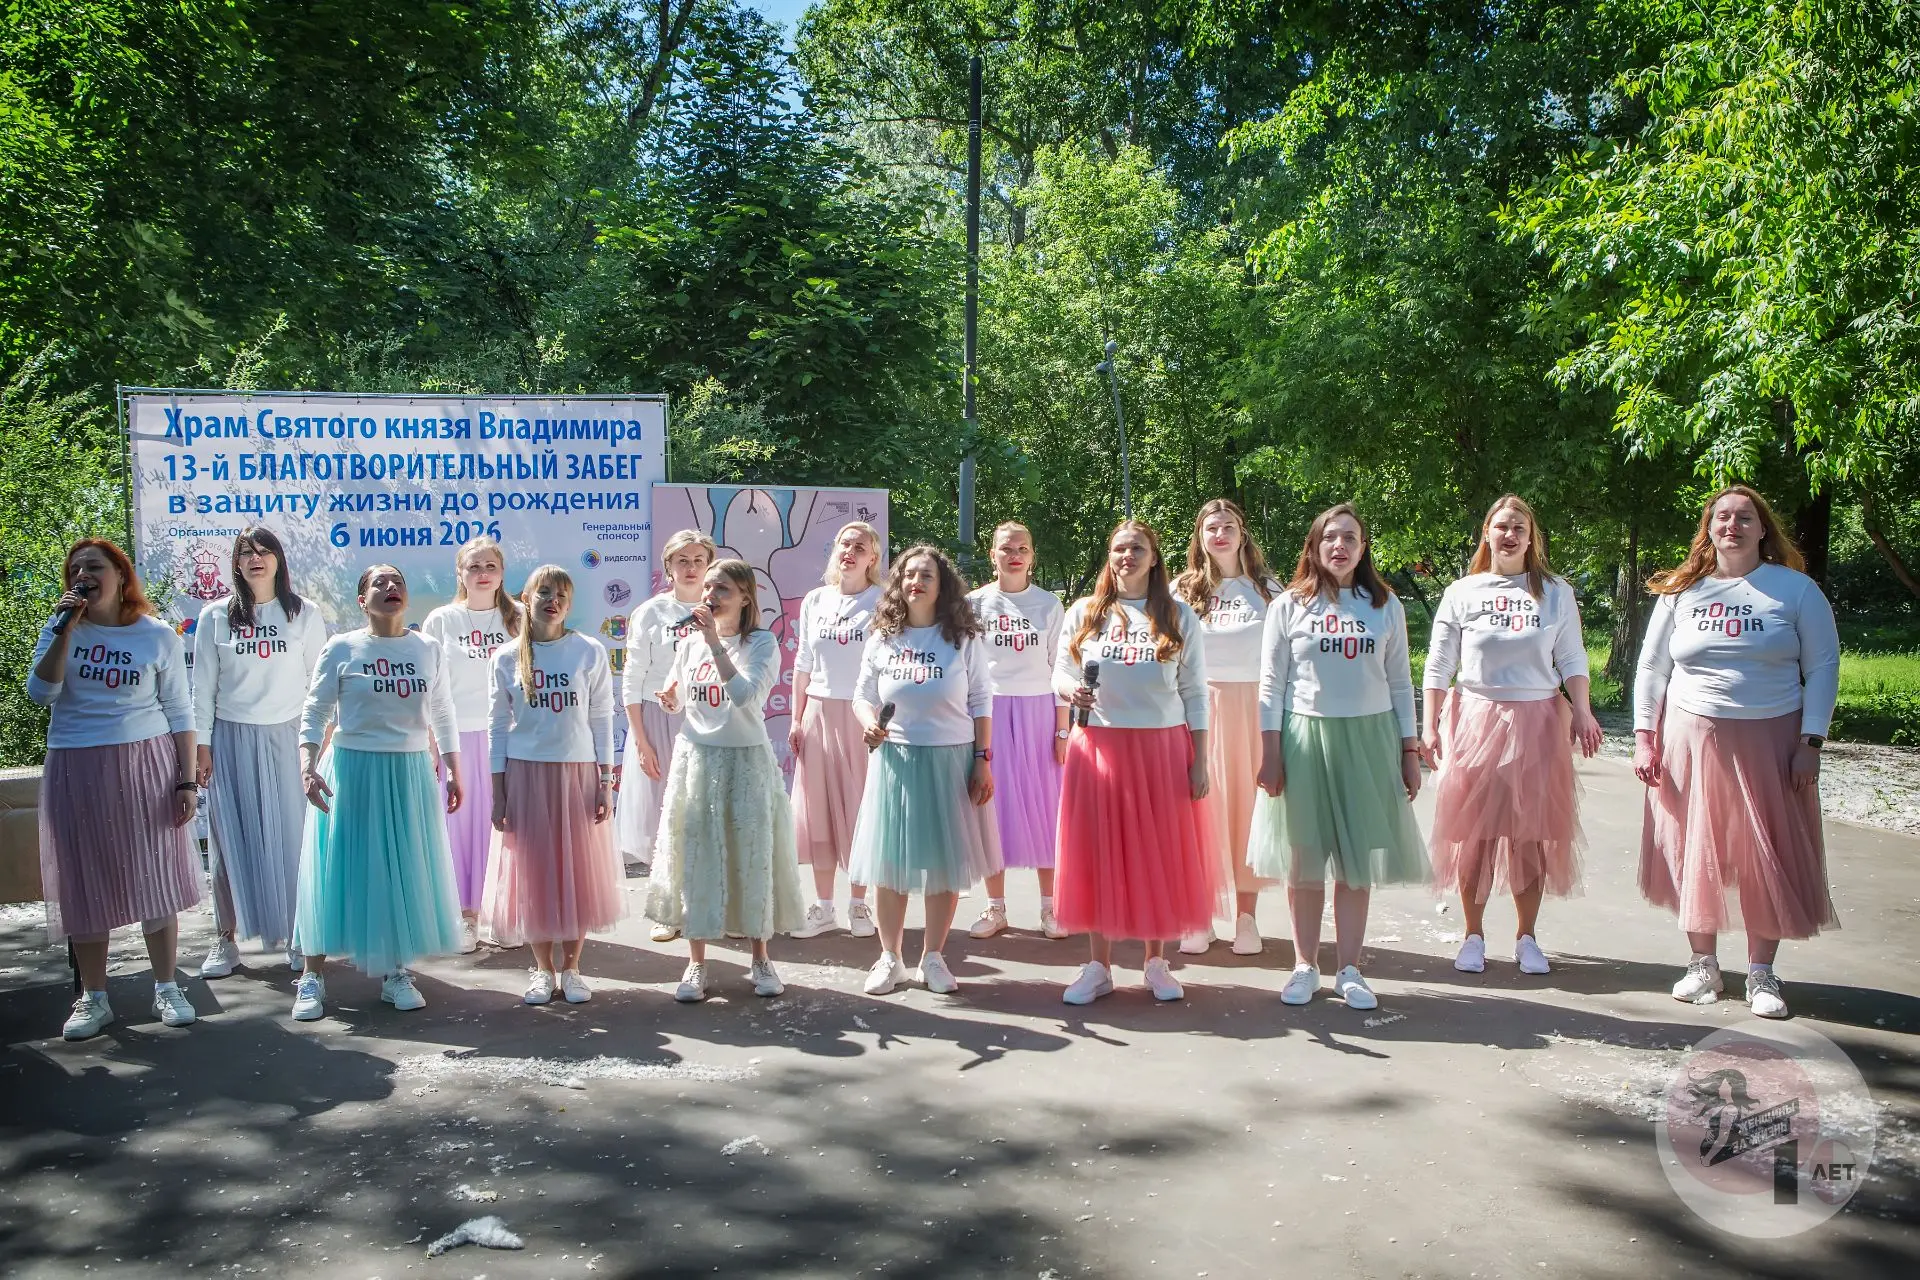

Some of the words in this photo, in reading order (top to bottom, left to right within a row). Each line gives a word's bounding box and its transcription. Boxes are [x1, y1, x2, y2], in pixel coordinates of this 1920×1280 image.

[163, 408, 248, 446] Храм
[256, 408, 377, 439] Святого
[385, 418, 471, 439] князя
[479, 411, 642, 447] Владимира
[163, 453, 229, 481] 13-й
[239, 449, 558, 481] БЛАГОТВОРИТЕЛЬНЫЙ
[566, 454, 642, 480] ЗАБЕГ
[168, 494, 186, 514] в
[196, 494, 320, 519] защиту
[328, 493, 432, 512] жизни
[440, 492, 479, 516] до
[488, 491, 640, 516] рождения
[168, 527, 242, 539] Организато
[330, 522, 350, 547] 6
[359, 527, 432, 547] июня
[582, 522, 651, 533] Генеральный
[596, 532, 640, 541] спонсор
[1209, 595, 1241, 611] OMS
[1481, 595, 1533, 612] MOMS
[1692, 602, 1753, 619] MOMS
[987, 614, 1030, 631] MOMS
[1311, 614, 1366, 635] MOMS
[1489, 613, 1541, 632] CHOIR
[1697, 618, 1765, 638] CHOIR
[459, 630, 505, 646] MOMS
[820, 629, 863, 645] CHOIR
[994, 633, 1039, 652] CHOIR
[1097, 625, 1149, 643] MOMS
[73, 644, 132, 665] MOMS
[235, 640, 287, 659] CHOIR
[888, 649, 936, 665] MOMS
[1101, 645, 1155, 666] CHOIR
[1319, 636, 1375, 660] CHOIR
[79, 664, 141, 689] CHOIR
[363, 658, 416, 677] MOMS
[688, 662, 719, 681] MOM
[893, 666, 943, 685] CHOIR
[373, 678, 428, 698] CHOIR
[520, 669, 570, 690] OMS
[691, 685, 730, 707] CHOI
